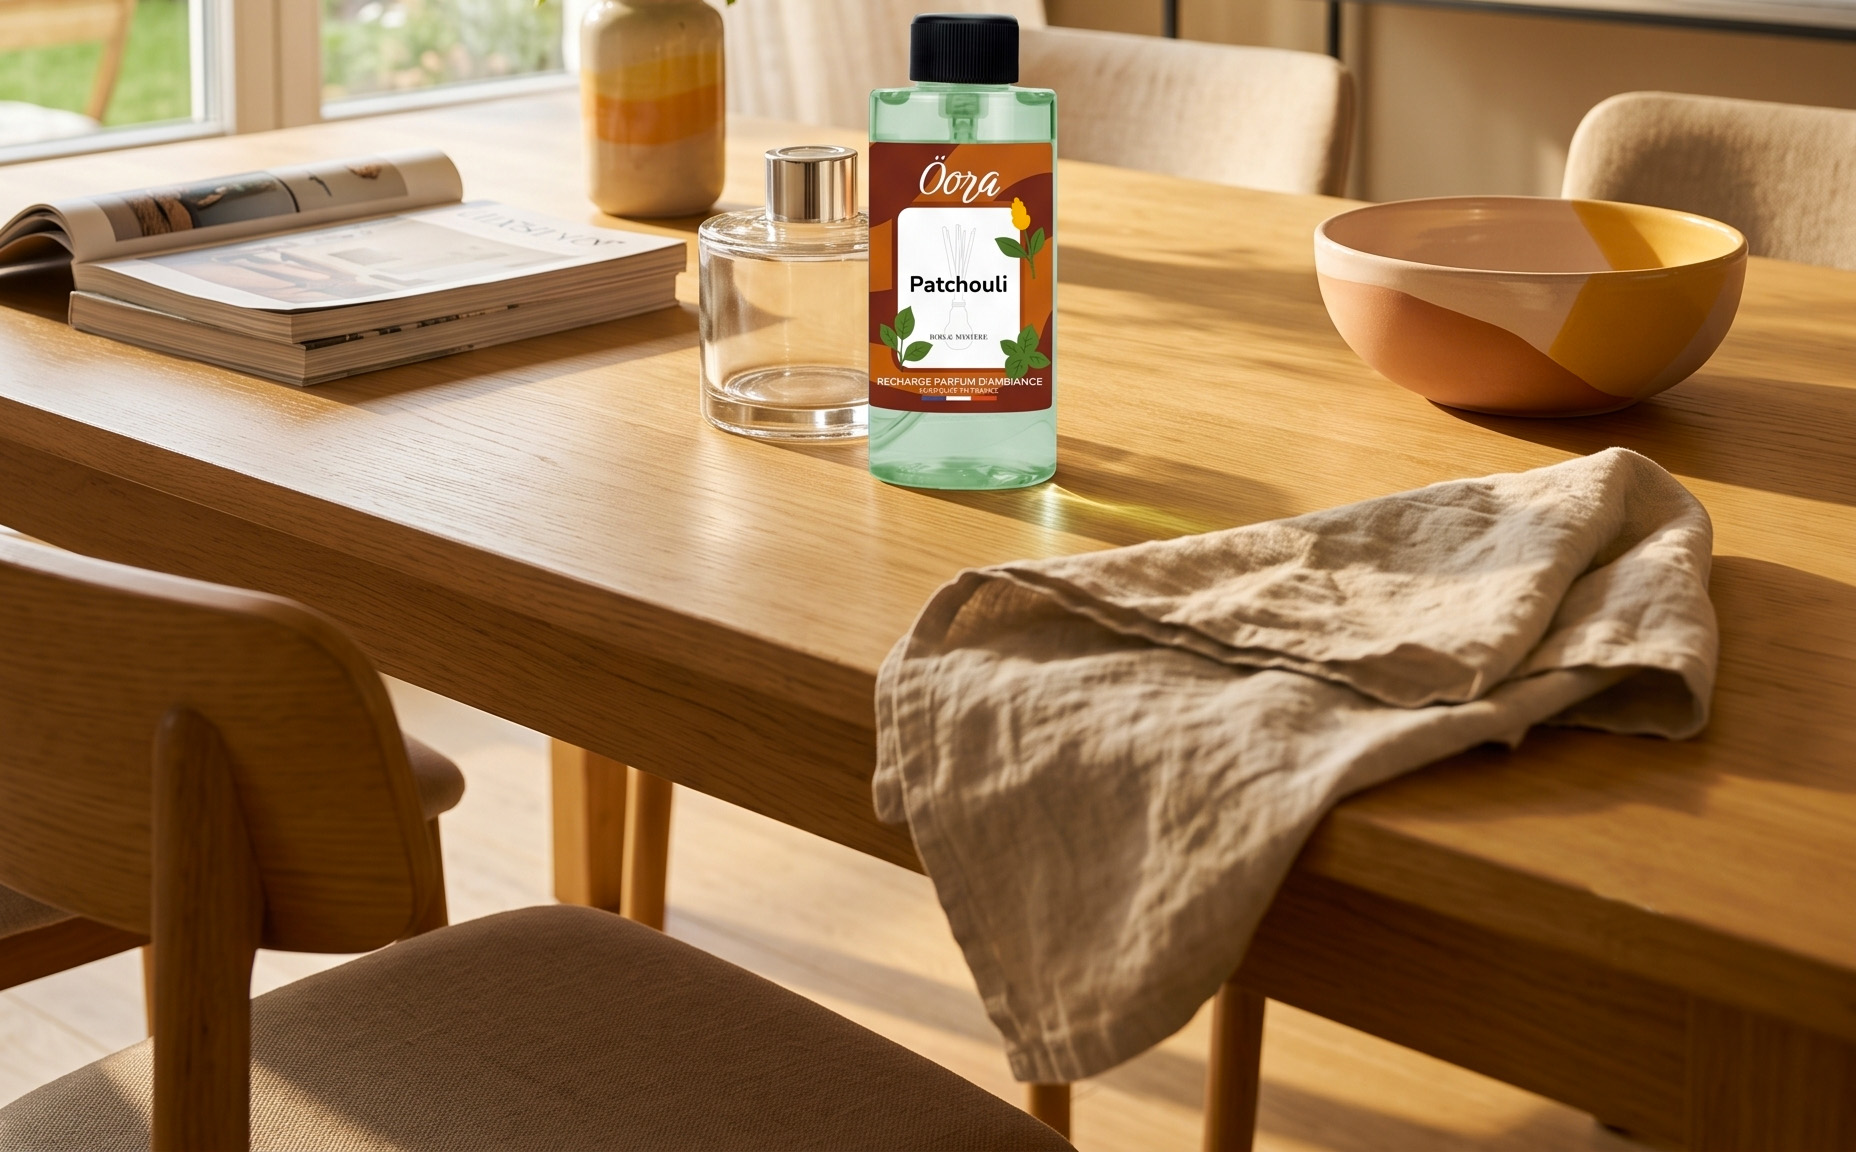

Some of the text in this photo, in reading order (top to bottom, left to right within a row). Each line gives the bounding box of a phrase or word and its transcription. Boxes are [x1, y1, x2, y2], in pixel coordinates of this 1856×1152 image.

[919, 155, 1001, 204] Öora
[910, 275, 1008, 294] Patchouli
[877, 377, 1043, 386] RECHARGE PARFUM D'AMBIANCE
